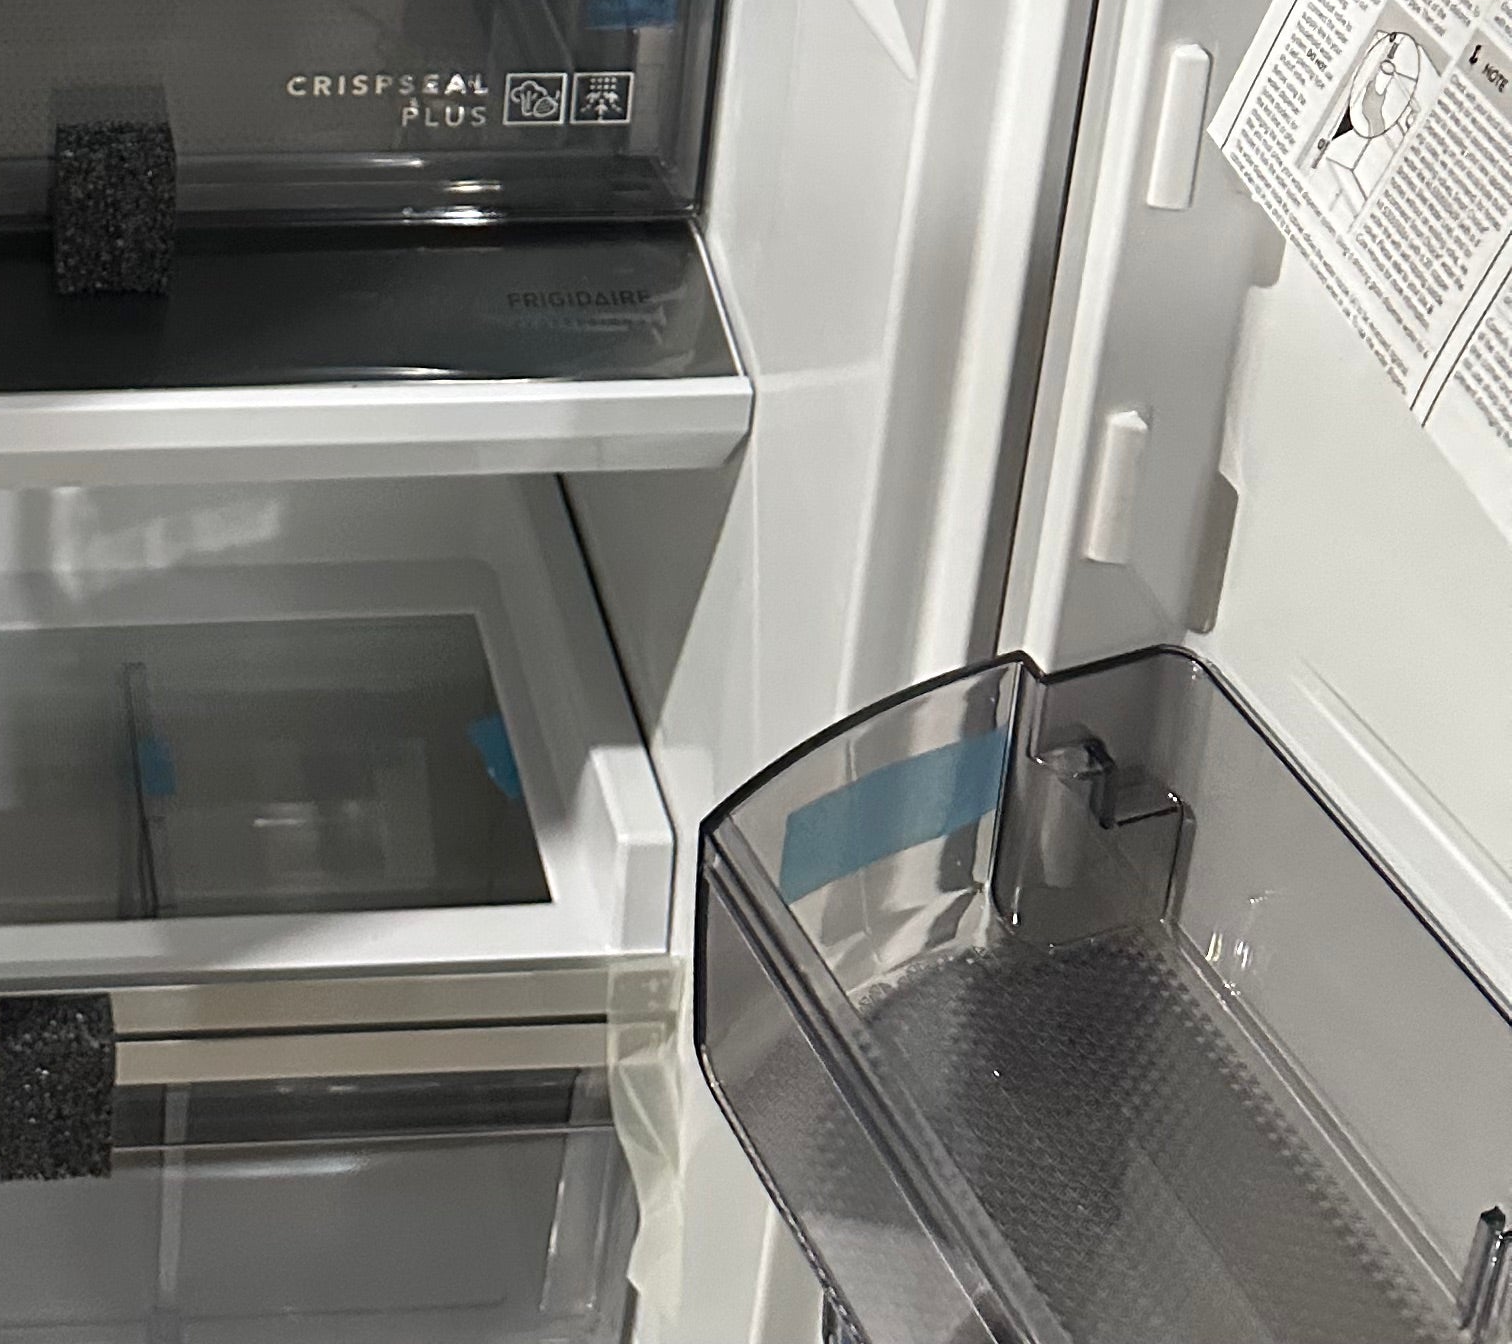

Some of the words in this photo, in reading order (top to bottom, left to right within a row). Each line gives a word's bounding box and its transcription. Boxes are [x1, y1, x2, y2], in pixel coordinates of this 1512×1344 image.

[286, 72, 489, 96] CRISPSEAL
[1482, 63, 1508, 92] NOTE
[402, 104, 487, 127] PLUS
